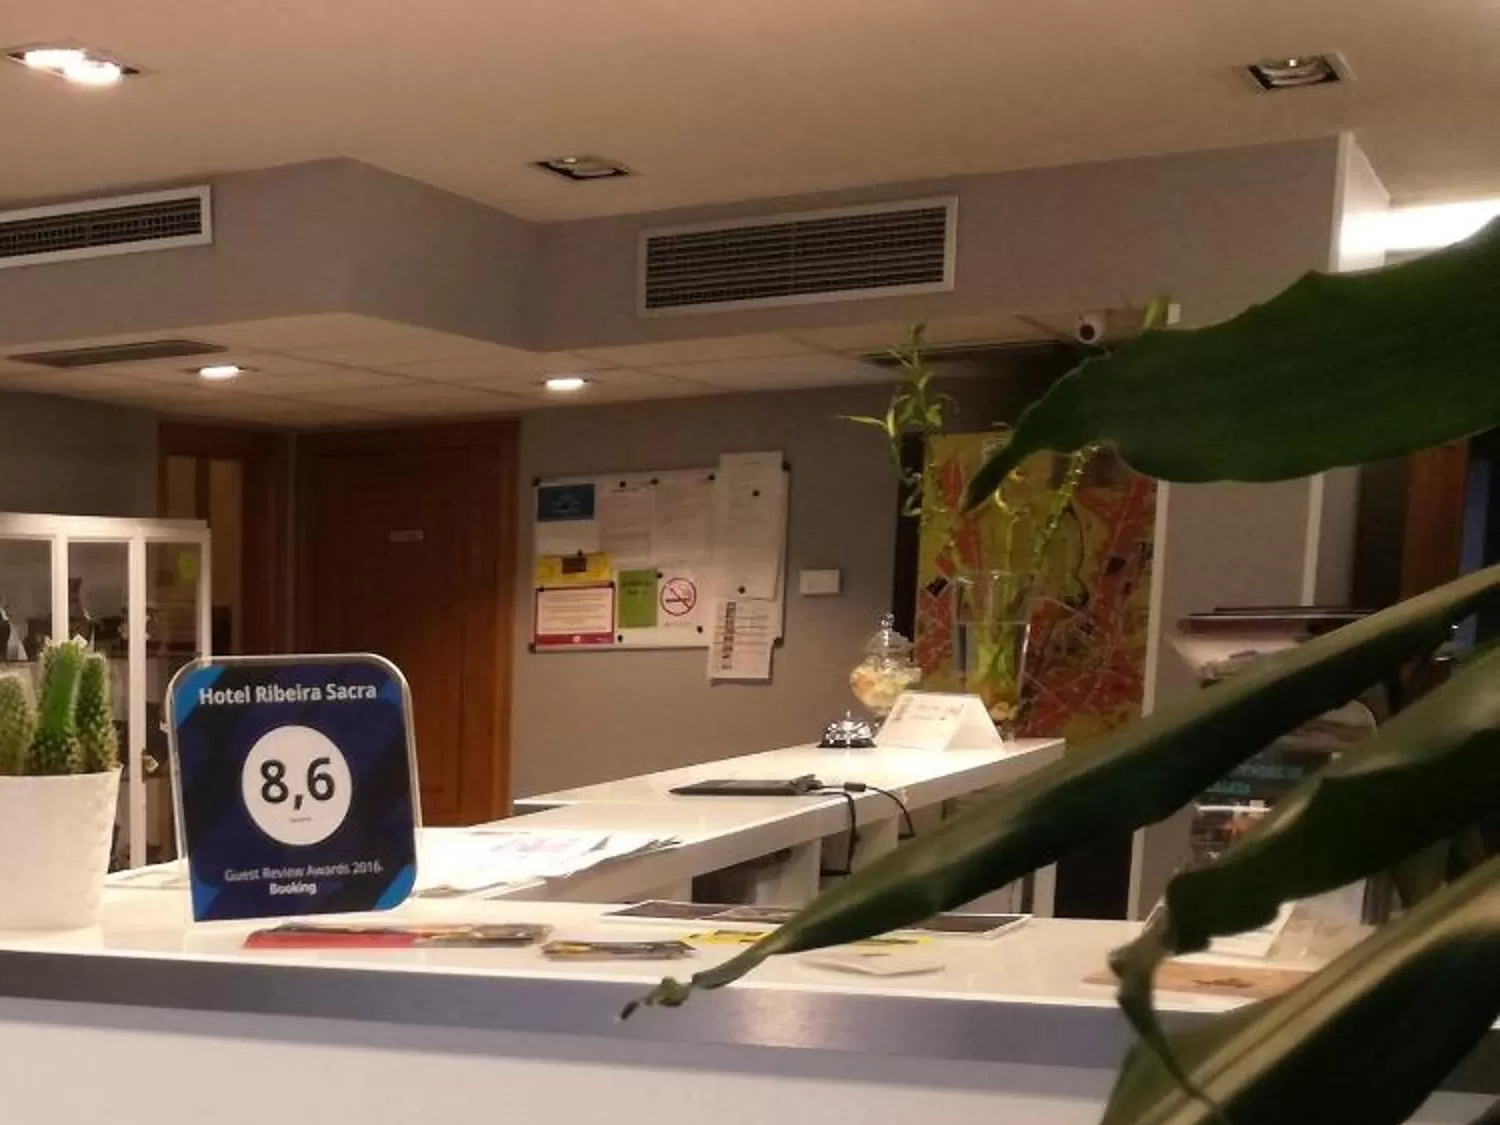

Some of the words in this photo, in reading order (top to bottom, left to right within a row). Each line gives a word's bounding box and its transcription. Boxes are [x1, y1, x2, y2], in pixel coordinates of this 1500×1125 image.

[199, 685, 250, 705] Hotel
[255, 683, 322, 703] Ribeira
[325, 683, 378, 700] Sacra
[259, 756, 336, 811] 8,6
[224, 868, 260, 882] Guest
[262, 864, 305, 880] Review
[306, 863, 350, 877] Awards
[269, 881, 317, 896] Booking
